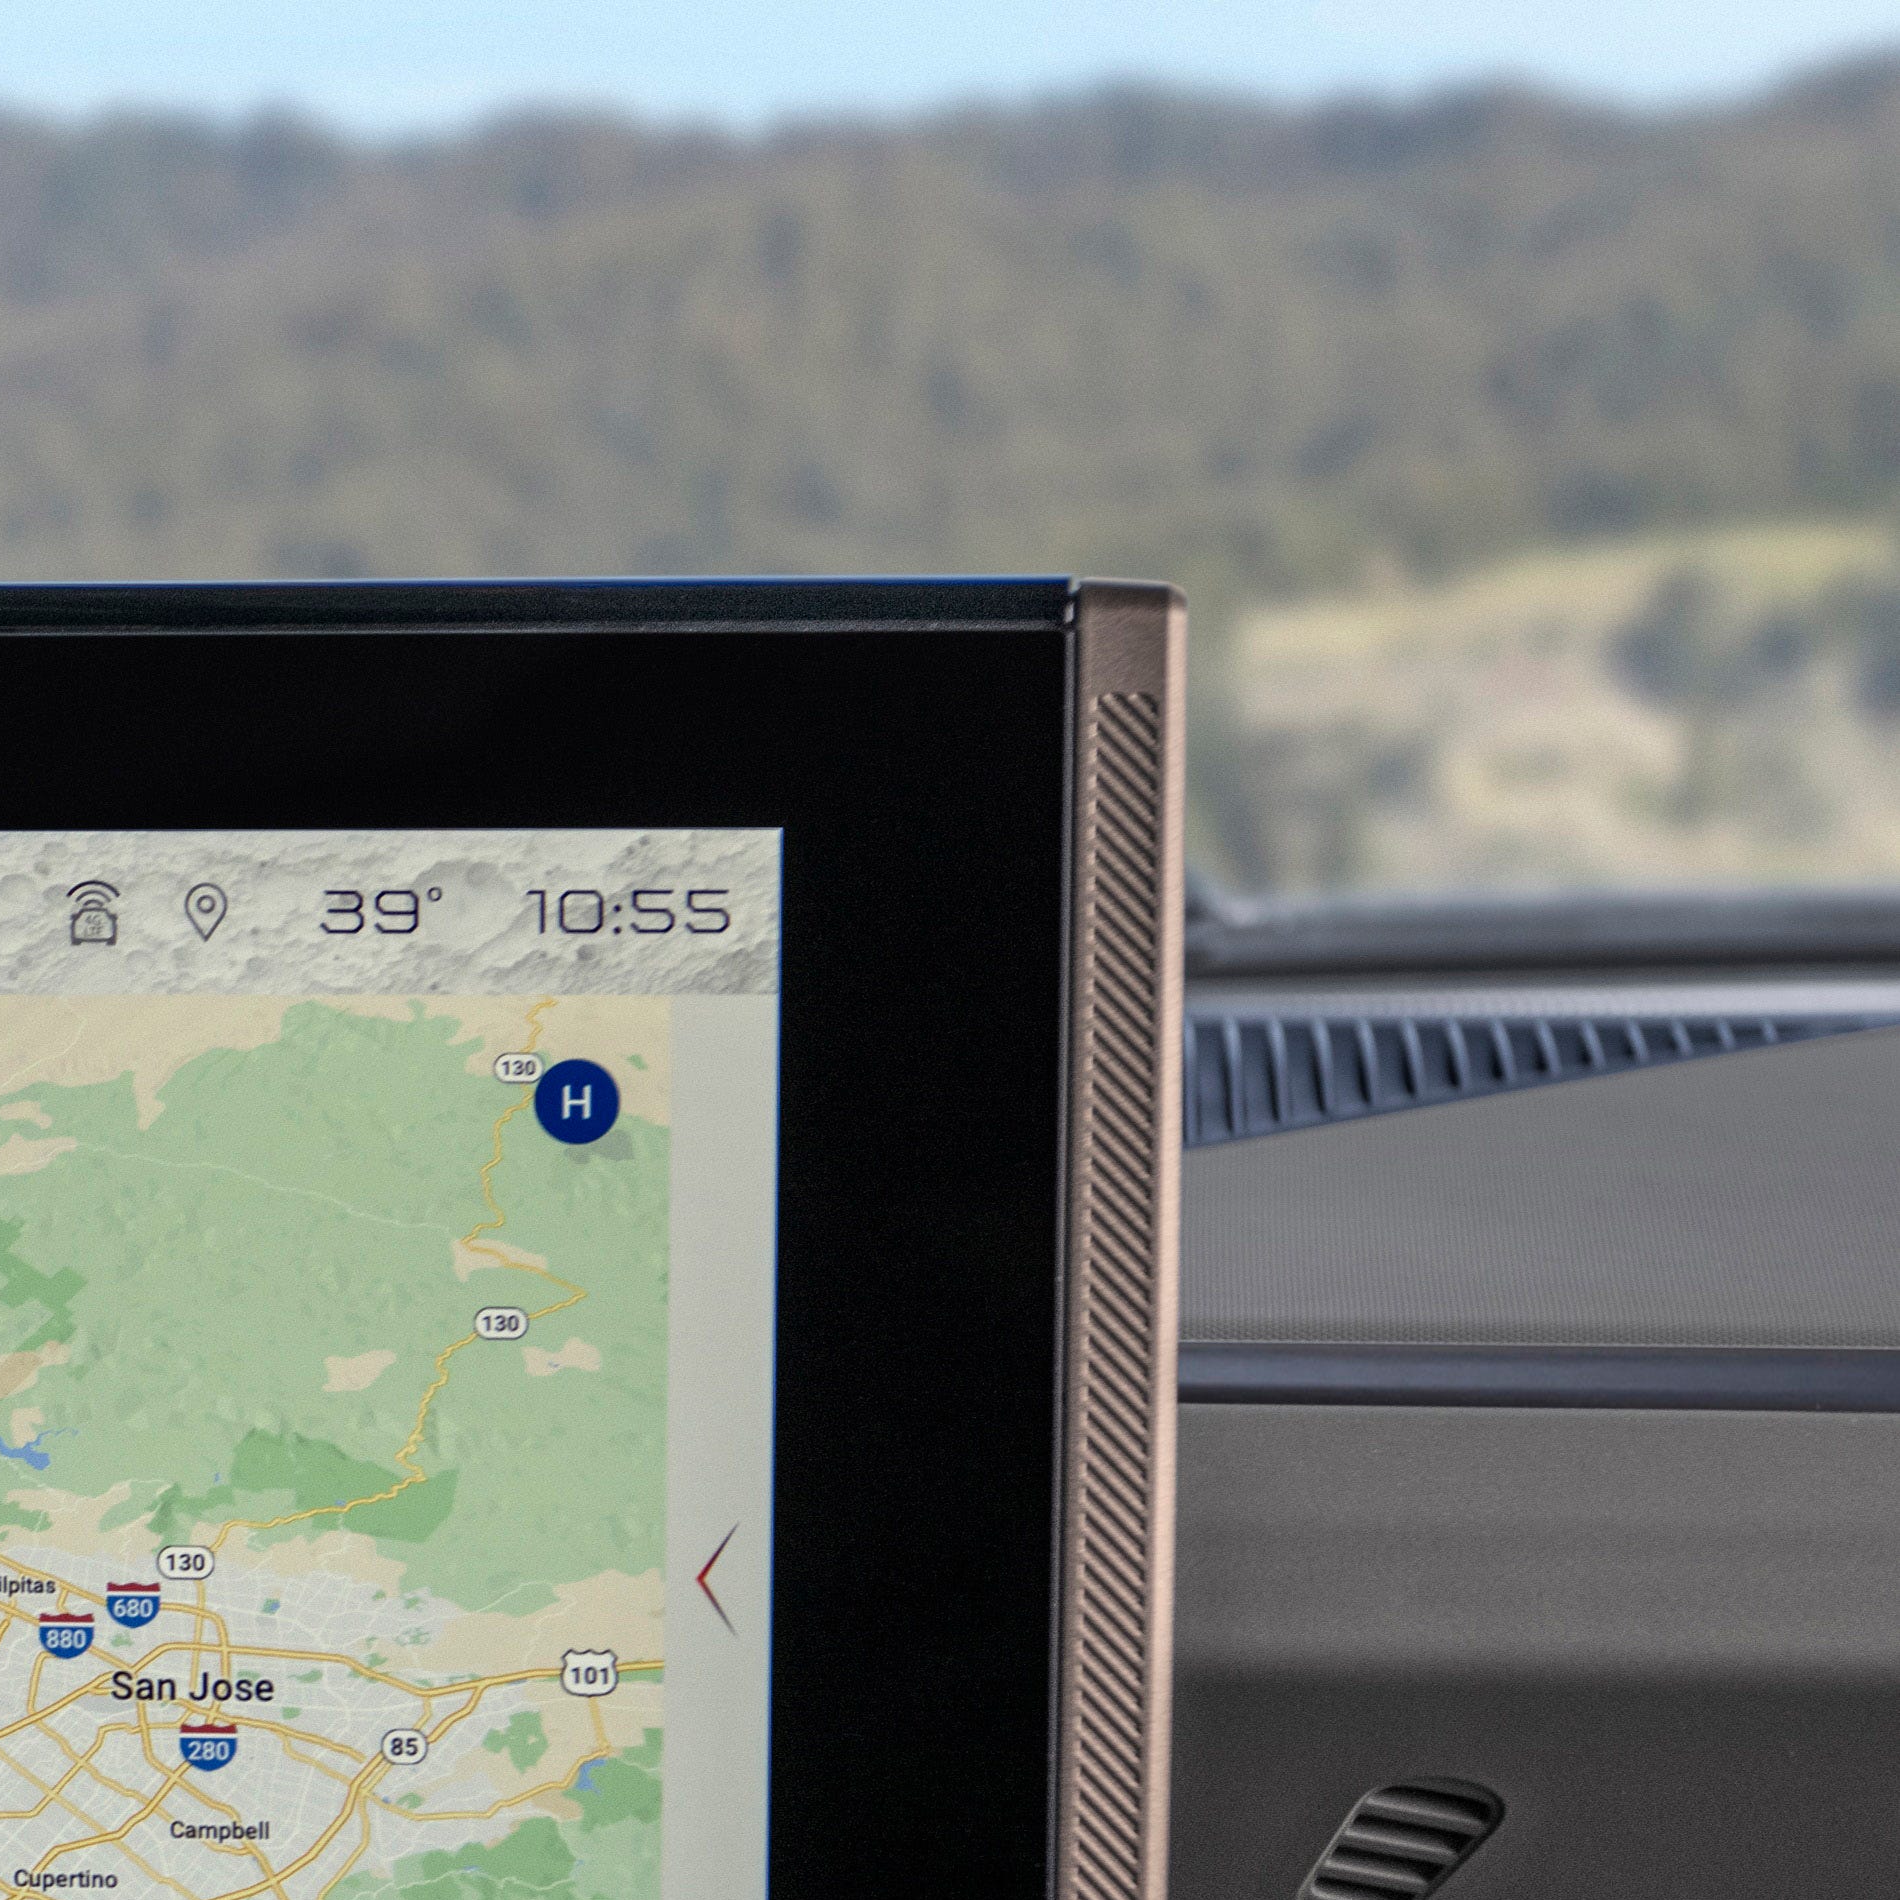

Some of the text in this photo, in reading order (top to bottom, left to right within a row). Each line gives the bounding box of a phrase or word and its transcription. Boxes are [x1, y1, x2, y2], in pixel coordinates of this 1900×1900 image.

[319, 886, 443, 936] 39°
[525, 888, 731, 936] 10:55
[500, 1059, 536, 1076] 130
[561, 1084, 592, 1120] H
[482, 1315, 520, 1333] 130
[166, 1554, 206, 1572] 130
[113, 1599, 153, 1618] 680
[46, 1630, 86, 1649] 880
[570, 1667, 611, 1686] 101
[111, 1672, 275, 1702] San Jose
[188, 1742, 230, 1761] 280
[390, 1738, 419, 1757] 85
[169, 1821, 271, 1844] Campbell
[13, 1869, 119, 1892] Cupertino
